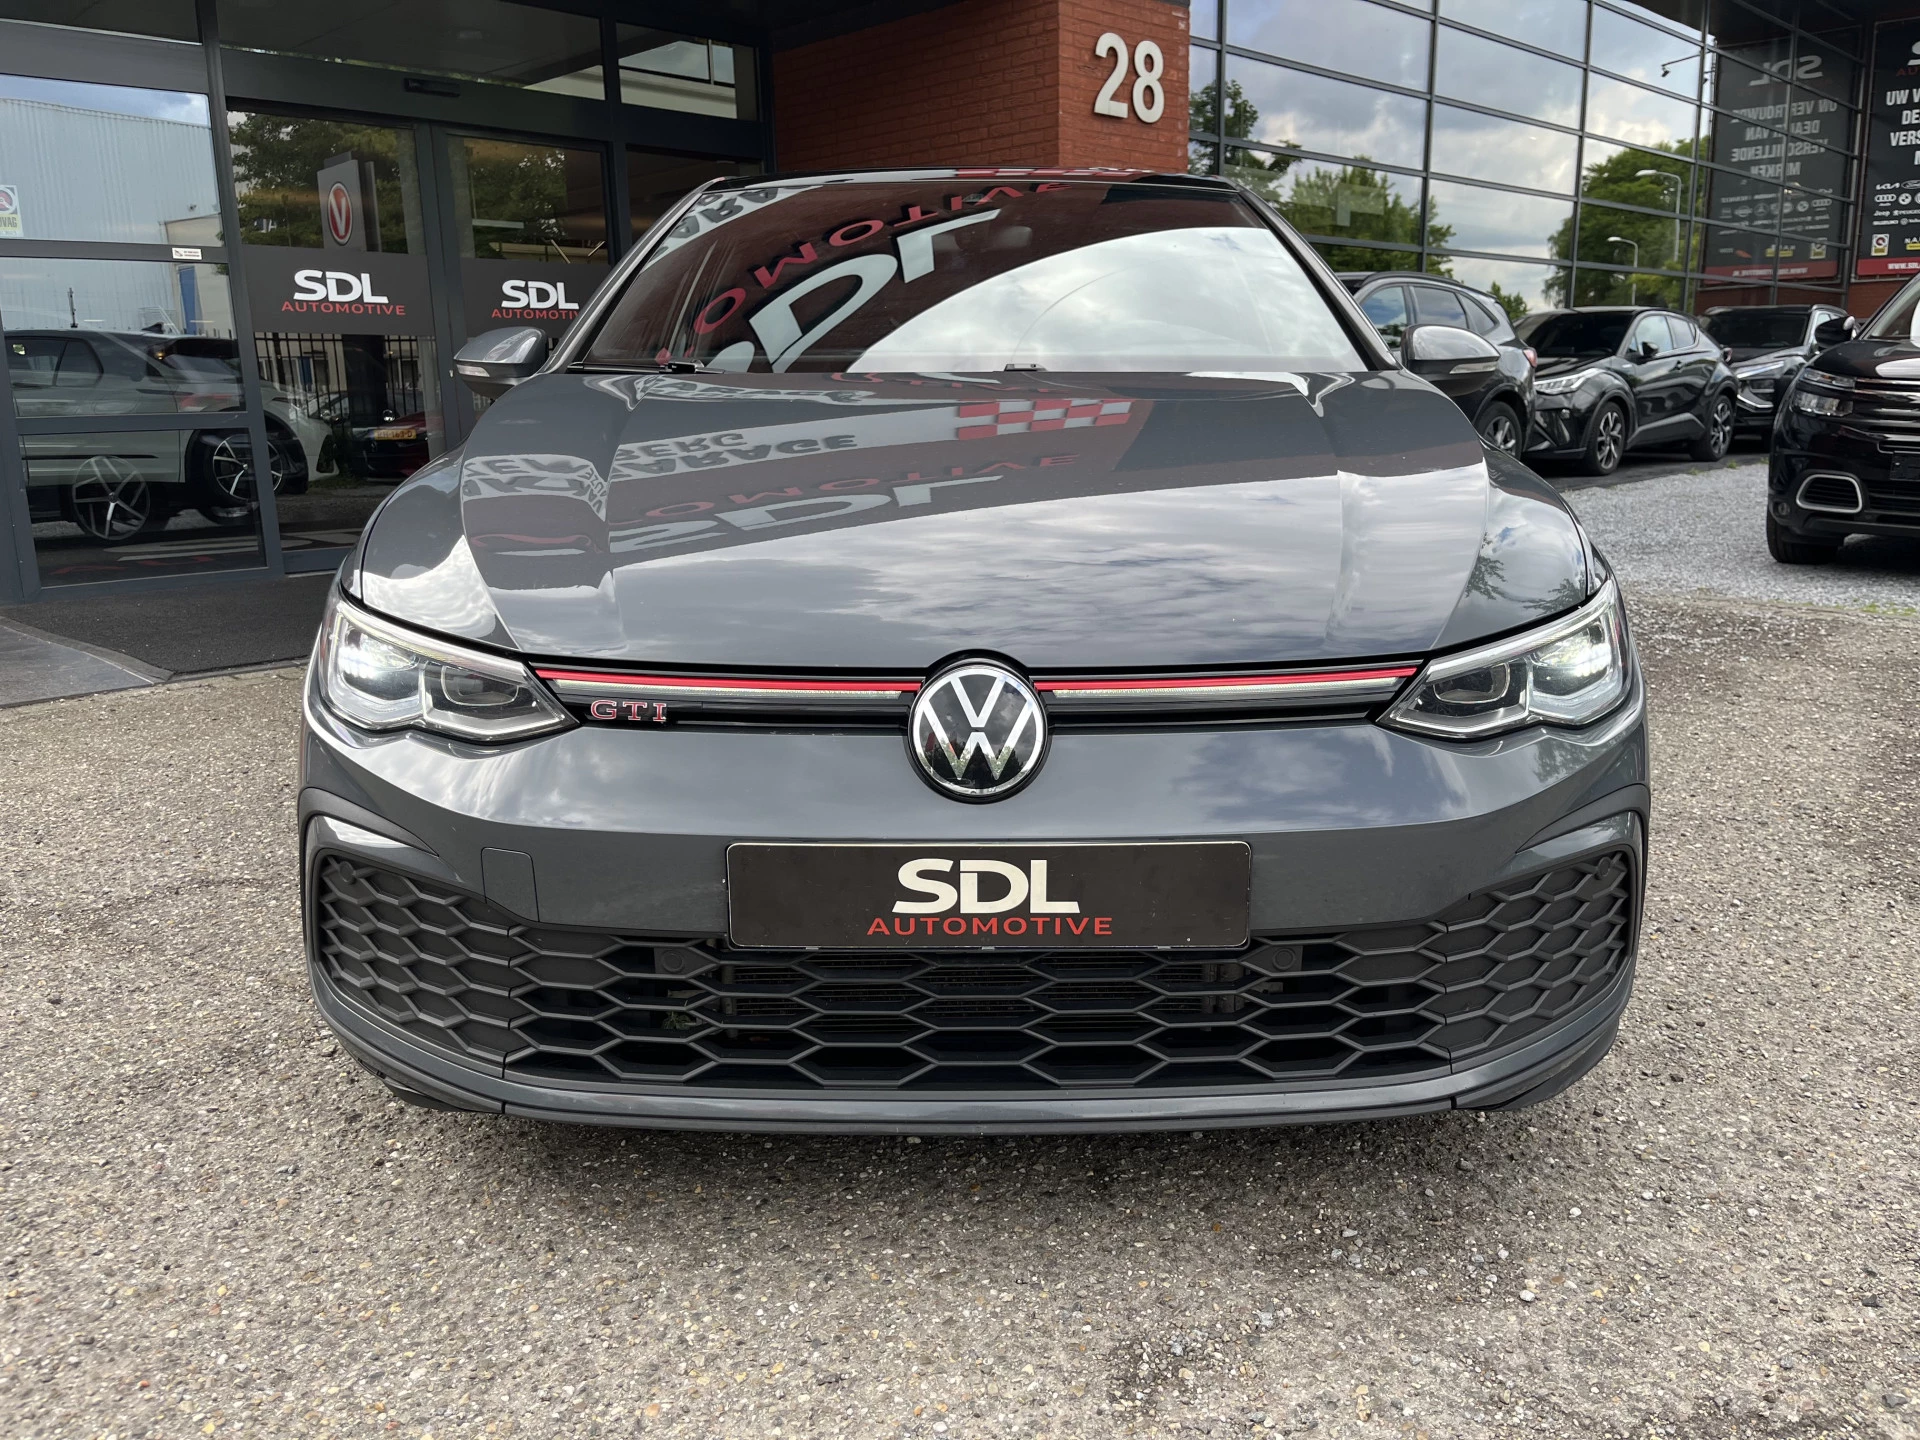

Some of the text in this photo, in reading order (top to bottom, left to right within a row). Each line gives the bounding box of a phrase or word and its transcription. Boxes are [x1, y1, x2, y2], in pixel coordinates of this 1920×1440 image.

[1093, 32, 1165, 123] 28
[1886, 90, 1909, 106] UW
[293, 269, 389, 304] SDL
[500, 279, 580, 310] SDL
[281, 300, 406, 316] AUTOMOTIVE
[590, 699, 667, 722] GTI
[892, 858, 1080, 915] SDL
[866, 916, 1113, 936] AUTOMOTIVE
